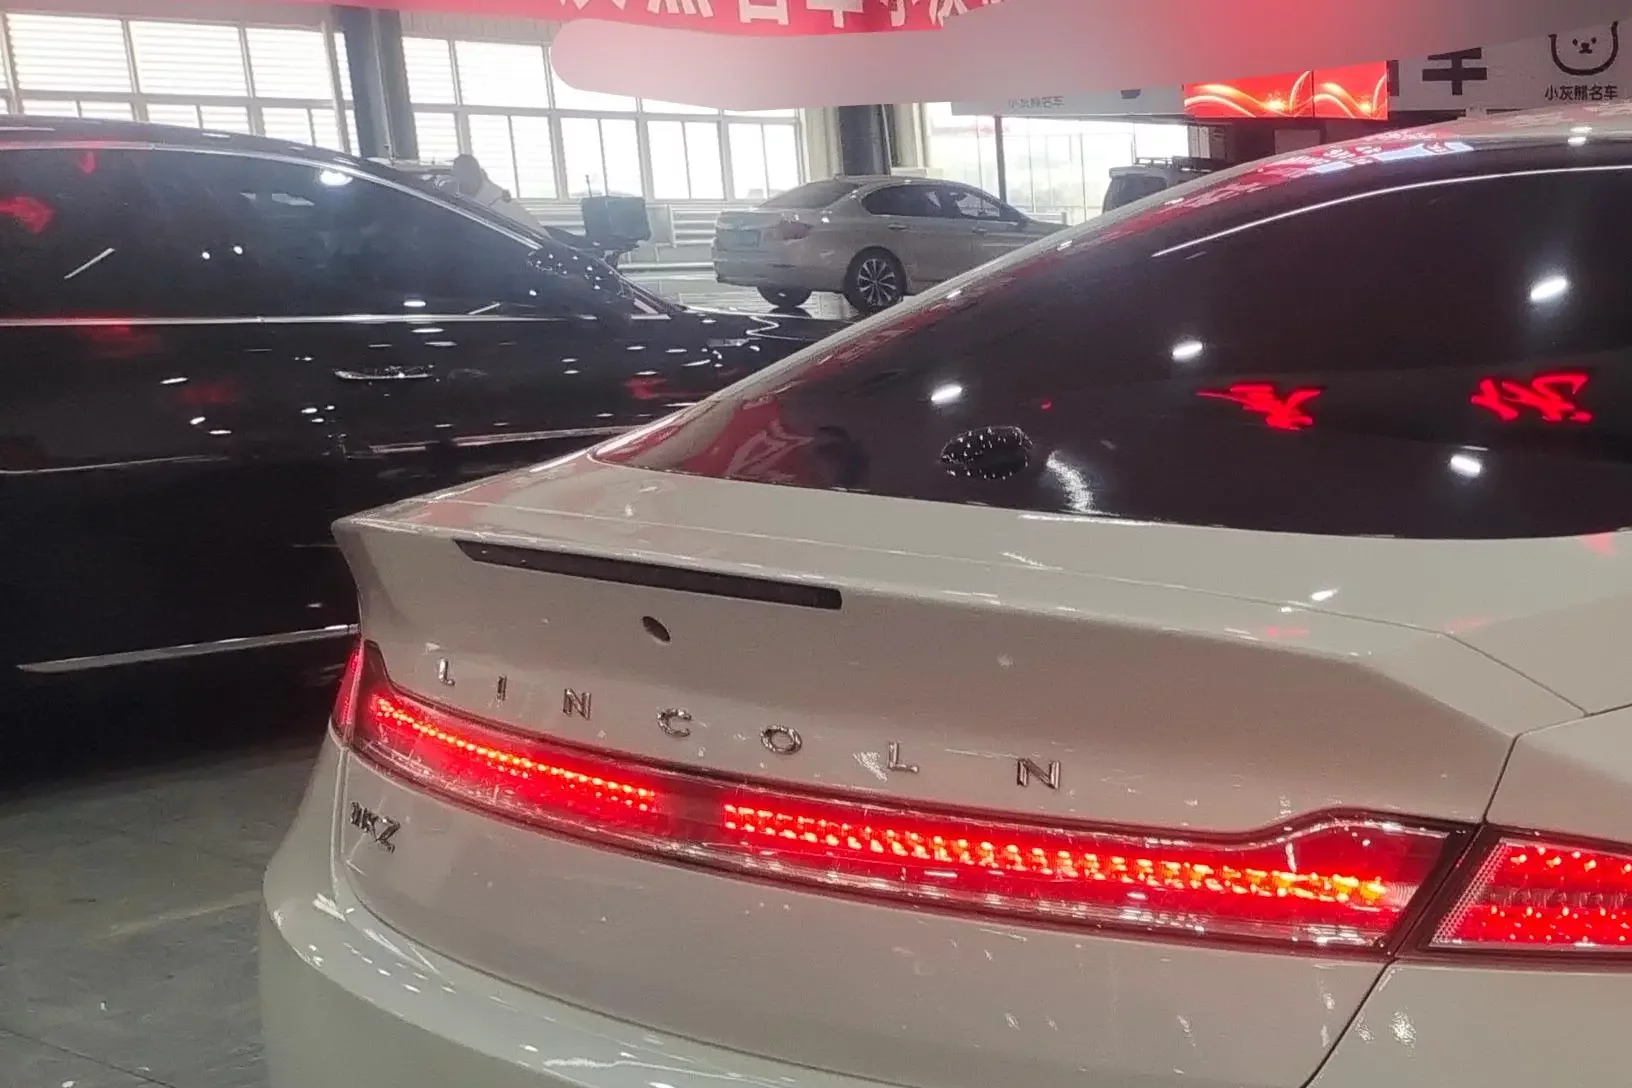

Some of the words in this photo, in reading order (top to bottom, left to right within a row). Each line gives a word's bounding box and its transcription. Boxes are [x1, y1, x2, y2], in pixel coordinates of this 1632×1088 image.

[1544, 84, 1618, 101] 小灰熊名车
[438, 656, 1062, 790] LINCOLN
